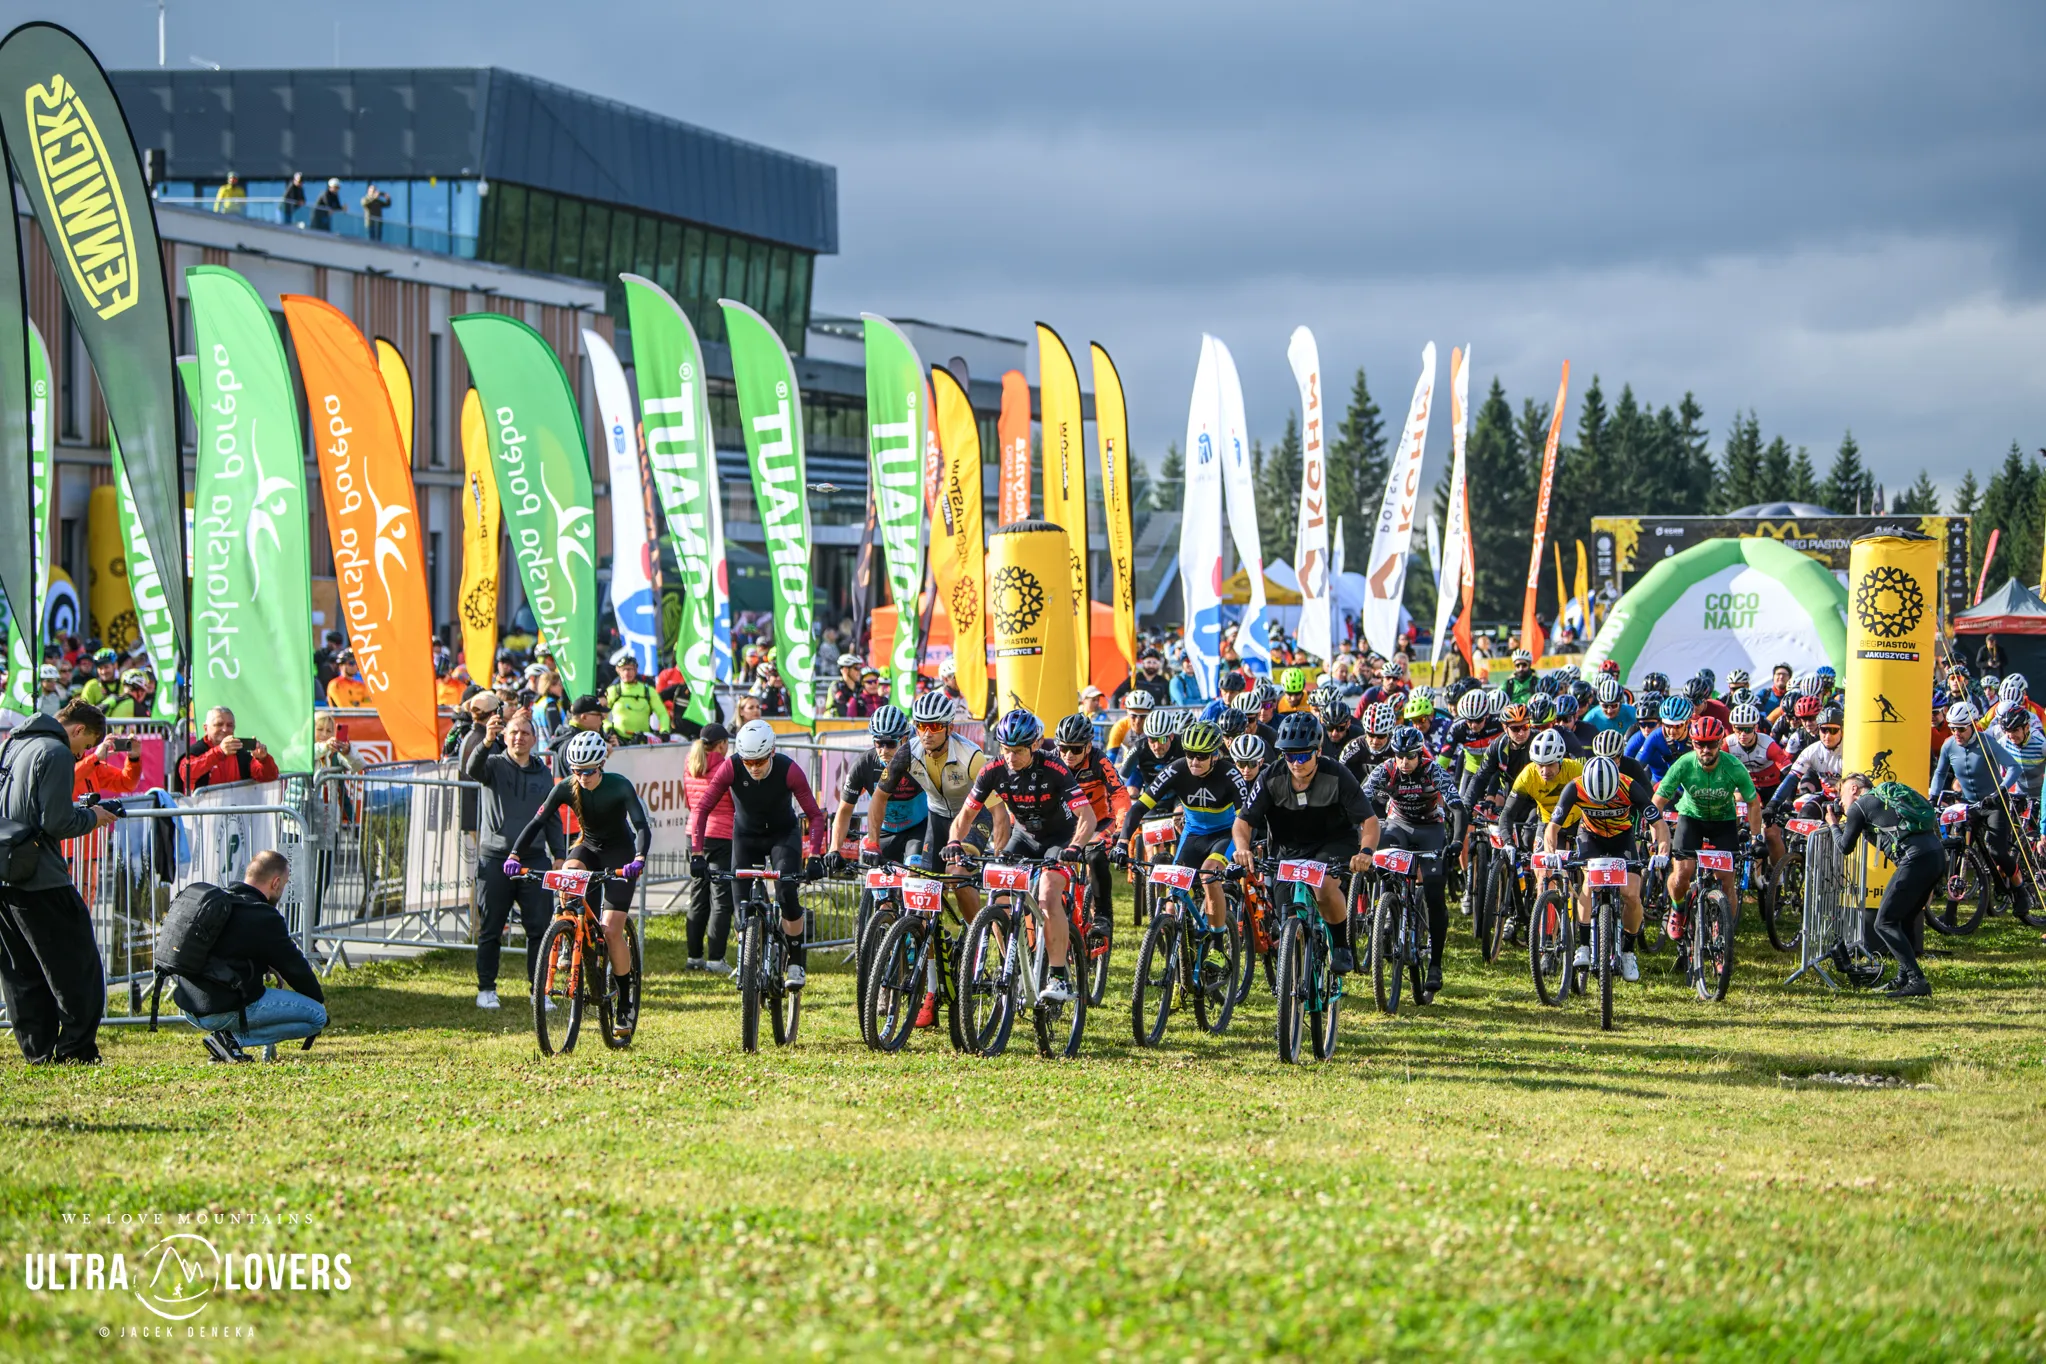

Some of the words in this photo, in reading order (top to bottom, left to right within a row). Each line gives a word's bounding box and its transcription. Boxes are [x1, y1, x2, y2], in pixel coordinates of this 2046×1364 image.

[1705, 593, 1760, 611] COCO
[1704, 611, 1759, 630] NAUT
[1865, 651, 1910, 660] JAKUSZYCE
[1149, 764, 1178, 796] ALEK
[1155, 832, 1163, 840] 3
[1711, 858, 1722, 867] 71
[1164, 873, 1180, 882] 76
[1292, 868, 1310, 878] 59
[1603, 873, 1611, 881] 5
[879, 875, 895, 884] 83
[998, 873, 1015, 885] 78
[910, 895, 932, 906] 107
